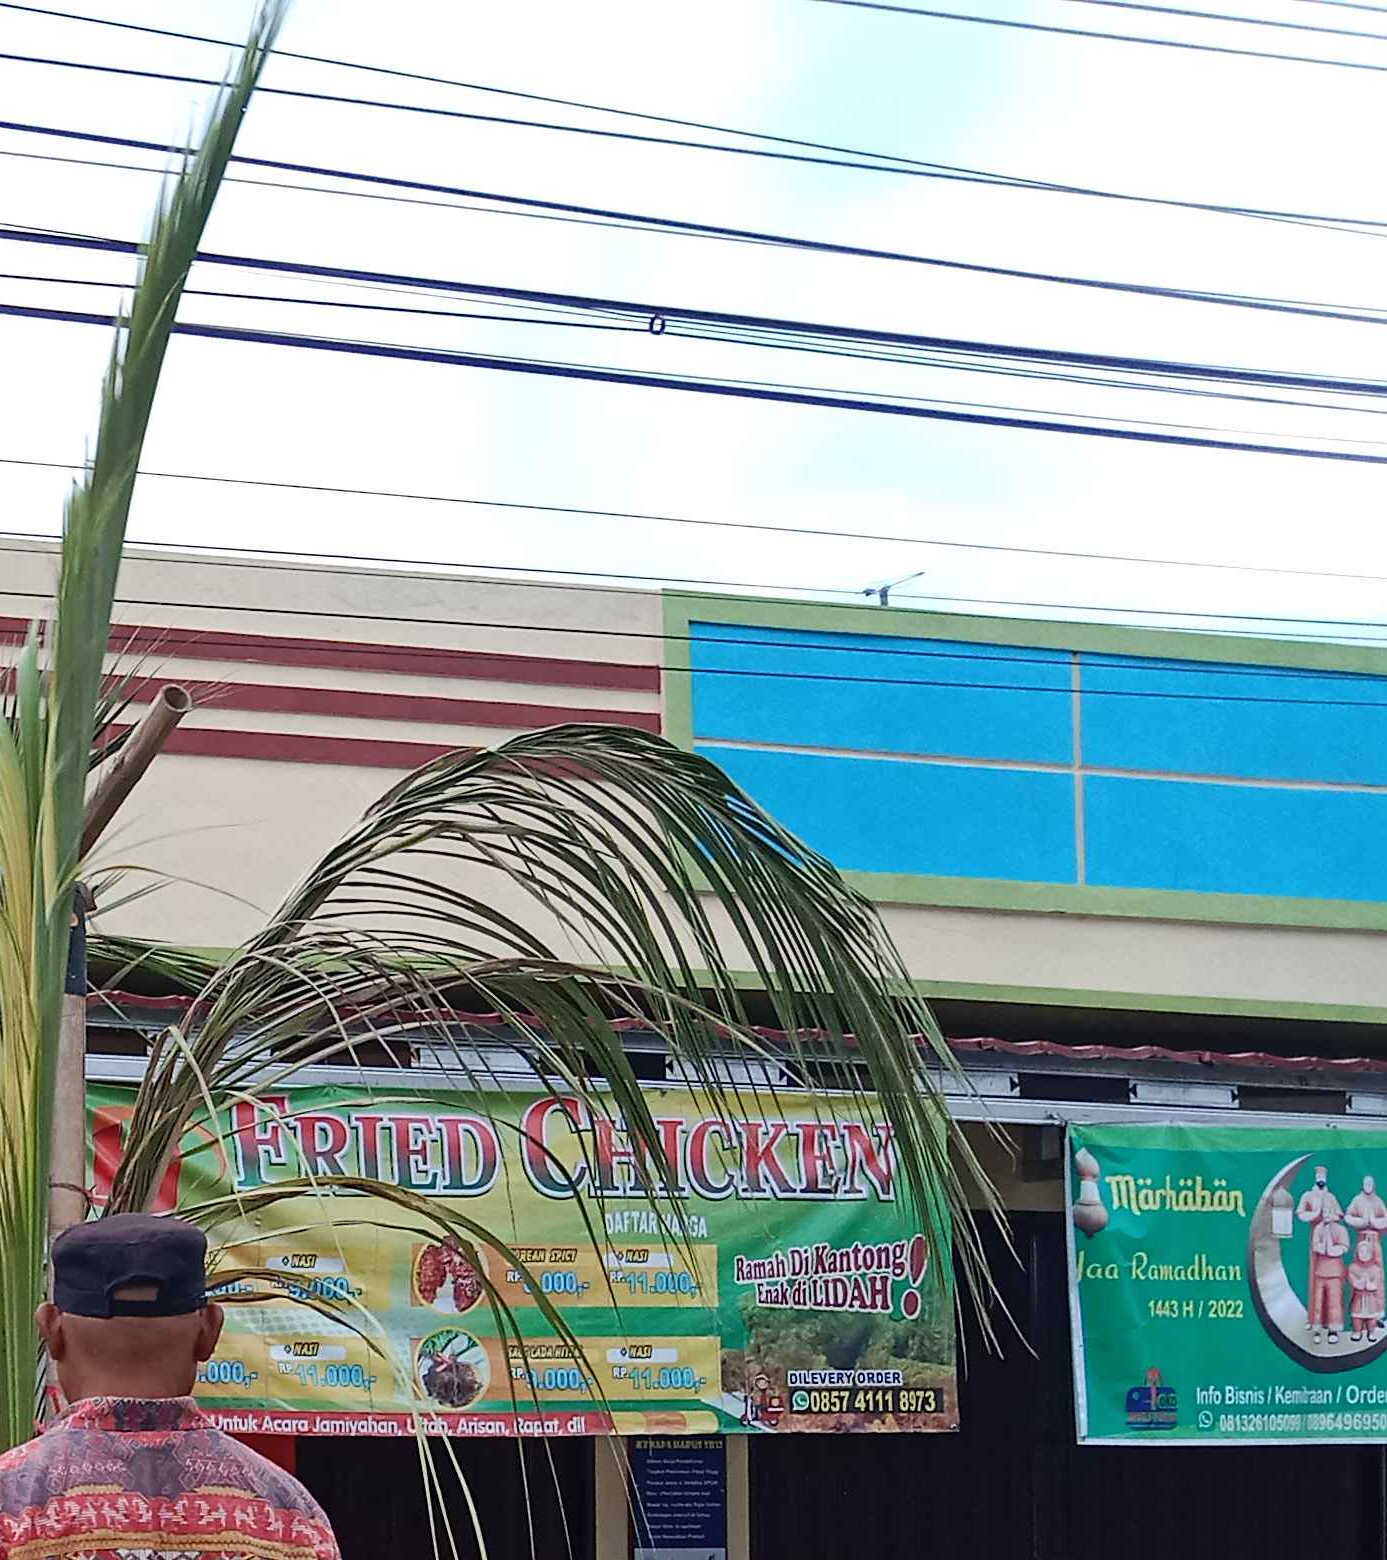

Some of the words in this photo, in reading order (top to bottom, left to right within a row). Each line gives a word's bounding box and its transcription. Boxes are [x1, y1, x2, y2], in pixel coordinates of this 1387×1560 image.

[230, 1095, 500, 1197] FRIED
[522, 1096, 895, 1201] CHICKEN
[605, 1211, 657, 1235] DAFTAR
[291, 1254, 317, 1269] NASI
[625, 1249, 649, 1263] NASI
[736, 1252, 787, 1282] Ramah
[790, 1249, 809, 1277] Di
[813, 1243, 906, 1277] Kantong
[1131, 1252, 1241, 1281] Ramadhan
[758, 1283, 788, 1305] Enak
[792, 1280, 807, 1306] di
[811, 1276, 891, 1311] LIDAH
[1148, 1299, 1178, 1317] 1443
[1182, 1300, 1194, 1317] H
[1208, 1299, 1244, 1318] 2022
[293, 1342, 319, 1356] NASI
[628, 1345, 652, 1359] NASI
[789, 1371, 855, 1385] DILEVERY
[857, 1371, 902, 1385] ORDER
[810, 1390, 849, 1412] 0857
[854, 1390, 894, 1412] 4111
[899, 1390, 936, 1412] 8973
[1196, 1385, 1222, 1405] Info
[1224, 1385, 1265, 1405] Bisnis
[211, 1414, 257, 1432] Untuk
[261, 1416, 308, 1433] Acara
[313, 1415, 403, 1437] Jamiyahan,
[406, 1416, 453, 1437] Utah,
[456, 1417, 510, 1437] Arisan,
[514, 1417, 564, 1438] Rapat,
[567, 1416, 585, 1434] dll
